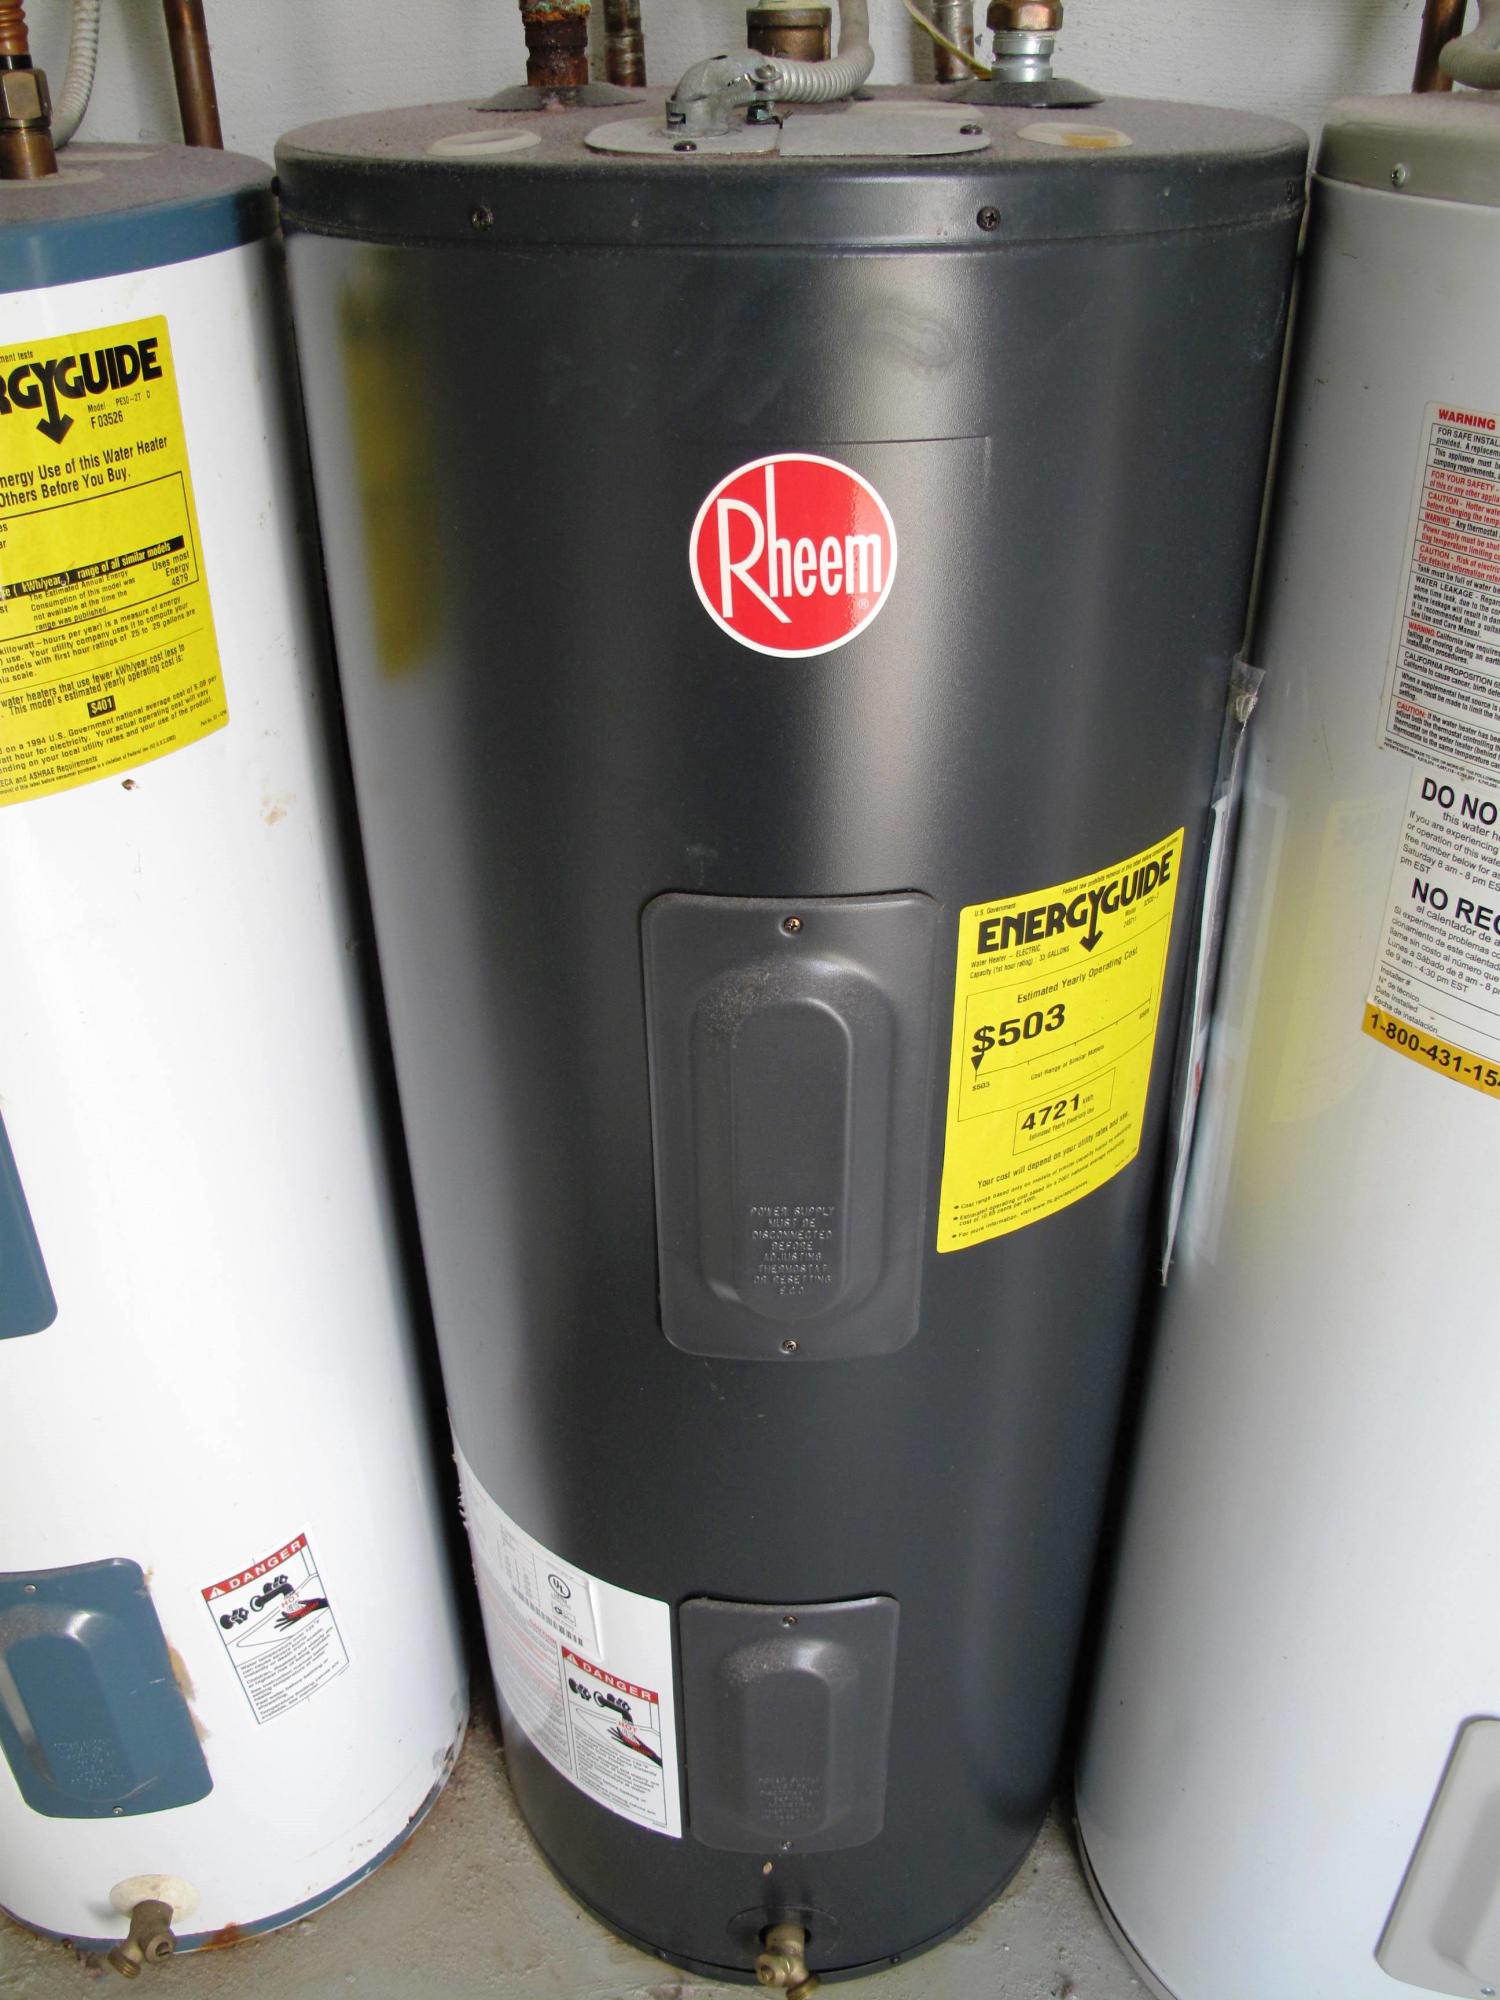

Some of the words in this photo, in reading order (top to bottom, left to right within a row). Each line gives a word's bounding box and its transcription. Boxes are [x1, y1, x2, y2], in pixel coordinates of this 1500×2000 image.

[18, 350, 34, 361] tests
[87, 403, 106, 413] Model
[1438, 408, 1496, 431] WARNING
[1437, 427, 1452, 437] FOR
[1453, 430, 1473, 442] SAFE
[38, 464, 61, 480] Use
[65, 458, 76, 474] of
[79, 454, 100, 471] this
[103, 447, 133, 464] Water
[136, 437, 167, 455] Heater
[1448, 452, 1475, 464] appliance
[41, 479, 79, 499] Before
[82, 473, 104, 488] You
[107, 467, 131, 482] Buy.
[1431, 470, 1445, 480] FOR
[1446, 474, 1466, 486] YOUR
[1467, 479, 1495, 491] SAFETY
[1427, 491, 1459, 506] CAUTION
[716, 463, 882, 624] Rheem
[1419, 544, 1450, 560] CAUTION
[152, 559, 170, 571] Uses
[173, 550, 190, 564] most
[165, 562, 190, 577] Energy
[45, 583, 79, 598] Estimated
[82, 575, 105, 588] Annual
[106, 570, 129, 582] Energy
[171, 573, 189, 586] 4879
[1415, 575, 1438, 588] WATER
[1440, 582, 1474, 599] LEAKAGE
[31, 594, 77, 611] Consumption
[102, 582, 121, 593] model
[47, 604, 79, 618] available
[120, 608, 150, 623] measure
[159, 597, 181, 608] energy
[1, 661, 33, 675] models
[35, 656, 52, 667] with
[54, 650, 71, 662] first
[72, 646, 91, 657] hour
[92, 638, 118, 652] ratings
[162, 613, 185, 628] gallons
[30, 648, 49, 658] Your
[51, 641, 74, 653] utility
[76, 631, 110, 645] company
[112, 624, 129, 635] uses
[146, 608, 173, 624] compute
[12, 671, 38, 682] scale.
[26, 687, 57, 702] heaters
[58, 681, 76, 693] that
[77, 677, 91, 688] use
[92, 671, 114, 684] fewer
[115, 658, 148, 676] kWh/year
[150, 652, 164, 664] cost
[1404, 651, 1443, 670] CALIFORNIA
[1444, 665, 1493, 687] PROPOSITION
[8, 704, 28, 716] This
[64, 684, 102, 702] estimated
[103, 676, 126, 692] yearly
[128, 663, 160, 682] operating
[161, 657, 176, 669] cost
[68, 717, 115, 737] Government
[116, 707, 144, 721] national
[145, 697, 171, 713] average
[15, 750, 33, 761] hour
[96, 728, 113, 739] Your
[115, 717, 137, 731] actual
[138, 707, 170, 724] operating
[61, 747, 80, 758] local
[82, 741, 104, 753] utility
[56, 756, 99, 773] Requirements
[1421, 777, 1455, 809] DO
[1461, 793, 1498, 825] NO
[1416, 815, 1430, 825] you
[1431, 821, 1444, 832] are
[1446, 827, 1499, 855] experiencing
[1443, 811, 1460, 826] this
[1461, 820, 1491, 837] water
[1404, 833, 1419, 846] free
[1420, 841, 1451, 860] number
[1451, 854, 1477, 870] below
[1478, 864, 1491, 875] for
[1416, 827, 1452, 848] operation
[1464, 846, 1479, 859] this
[1402, 843, 1436, 867] Saturday
[1444, 864, 1458, 875] am
[1471, 875, 1487, 887] pm
[1413, 861, 1431, 875] EST
[976, 849, 1174, 954] ENERGYGUIDE
[986, 902, 1016, 914] Government
[1411, 877, 1449, 911] NO
[1391, 917, 1434, 943] cionamiento
[1446, 944, 1464, 956] este
[1402, 911, 1447, 937] experimenta
[1448, 932, 1490, 955] problemas
[1426, 910, 1477, 937] calentador
[1478, 931, 1492, 943] de
[989, 955, 1007, 965] Heater
[1016, 944, 1041, 958] ELECTRIC
[1047, 945, 1070, 959] GALLONS
[1387, 936, 1409, 954] Lunes
[1416, 952, 1445, 971] Sábado
[1445, 966, 1457, 977] de
[1464, 975, 1478, 986] am
[1421, 944, 1442, 958] costo
[1451, 958, 1482, 976] número
[1483, 971, 1500, 983] que
[1017, 983, 1059, 1003] Estimated
[1062, 973, 1087, 988] Yearly
[1089, 956, 1122, 978] Operating
[1124, 946, 1138, 960] Cost
[1380, 966, 1404, 984] Installer
[1418, 966, 1436, 979] 4:30
[1436, 974, 1450, 986] pm
[1450, 980, 1469, 993] EST
[1396, 985, 1420, 1002] técnico
[972, 1004, 1065, 1054] $503
[1374, 995, 1393, 1011] Fecha
[1402, 1011, 1439, 1034] instalación
[1021, 1093, 1080, 1130] 4721
[977, 1177, 994, 1189] Your
[996, 1171, 1012, 1182] cost
[1013, 1165, 1026, 1177] will
[1027, 1155, 1052, 1171] depend
[1063, 1144, 1077, 1156] your
[1078, 1135, 1094, 1148] utility
[229, 1540, 302, 1589] DANGER
[582, 1662, 651, 1701] DANGER
